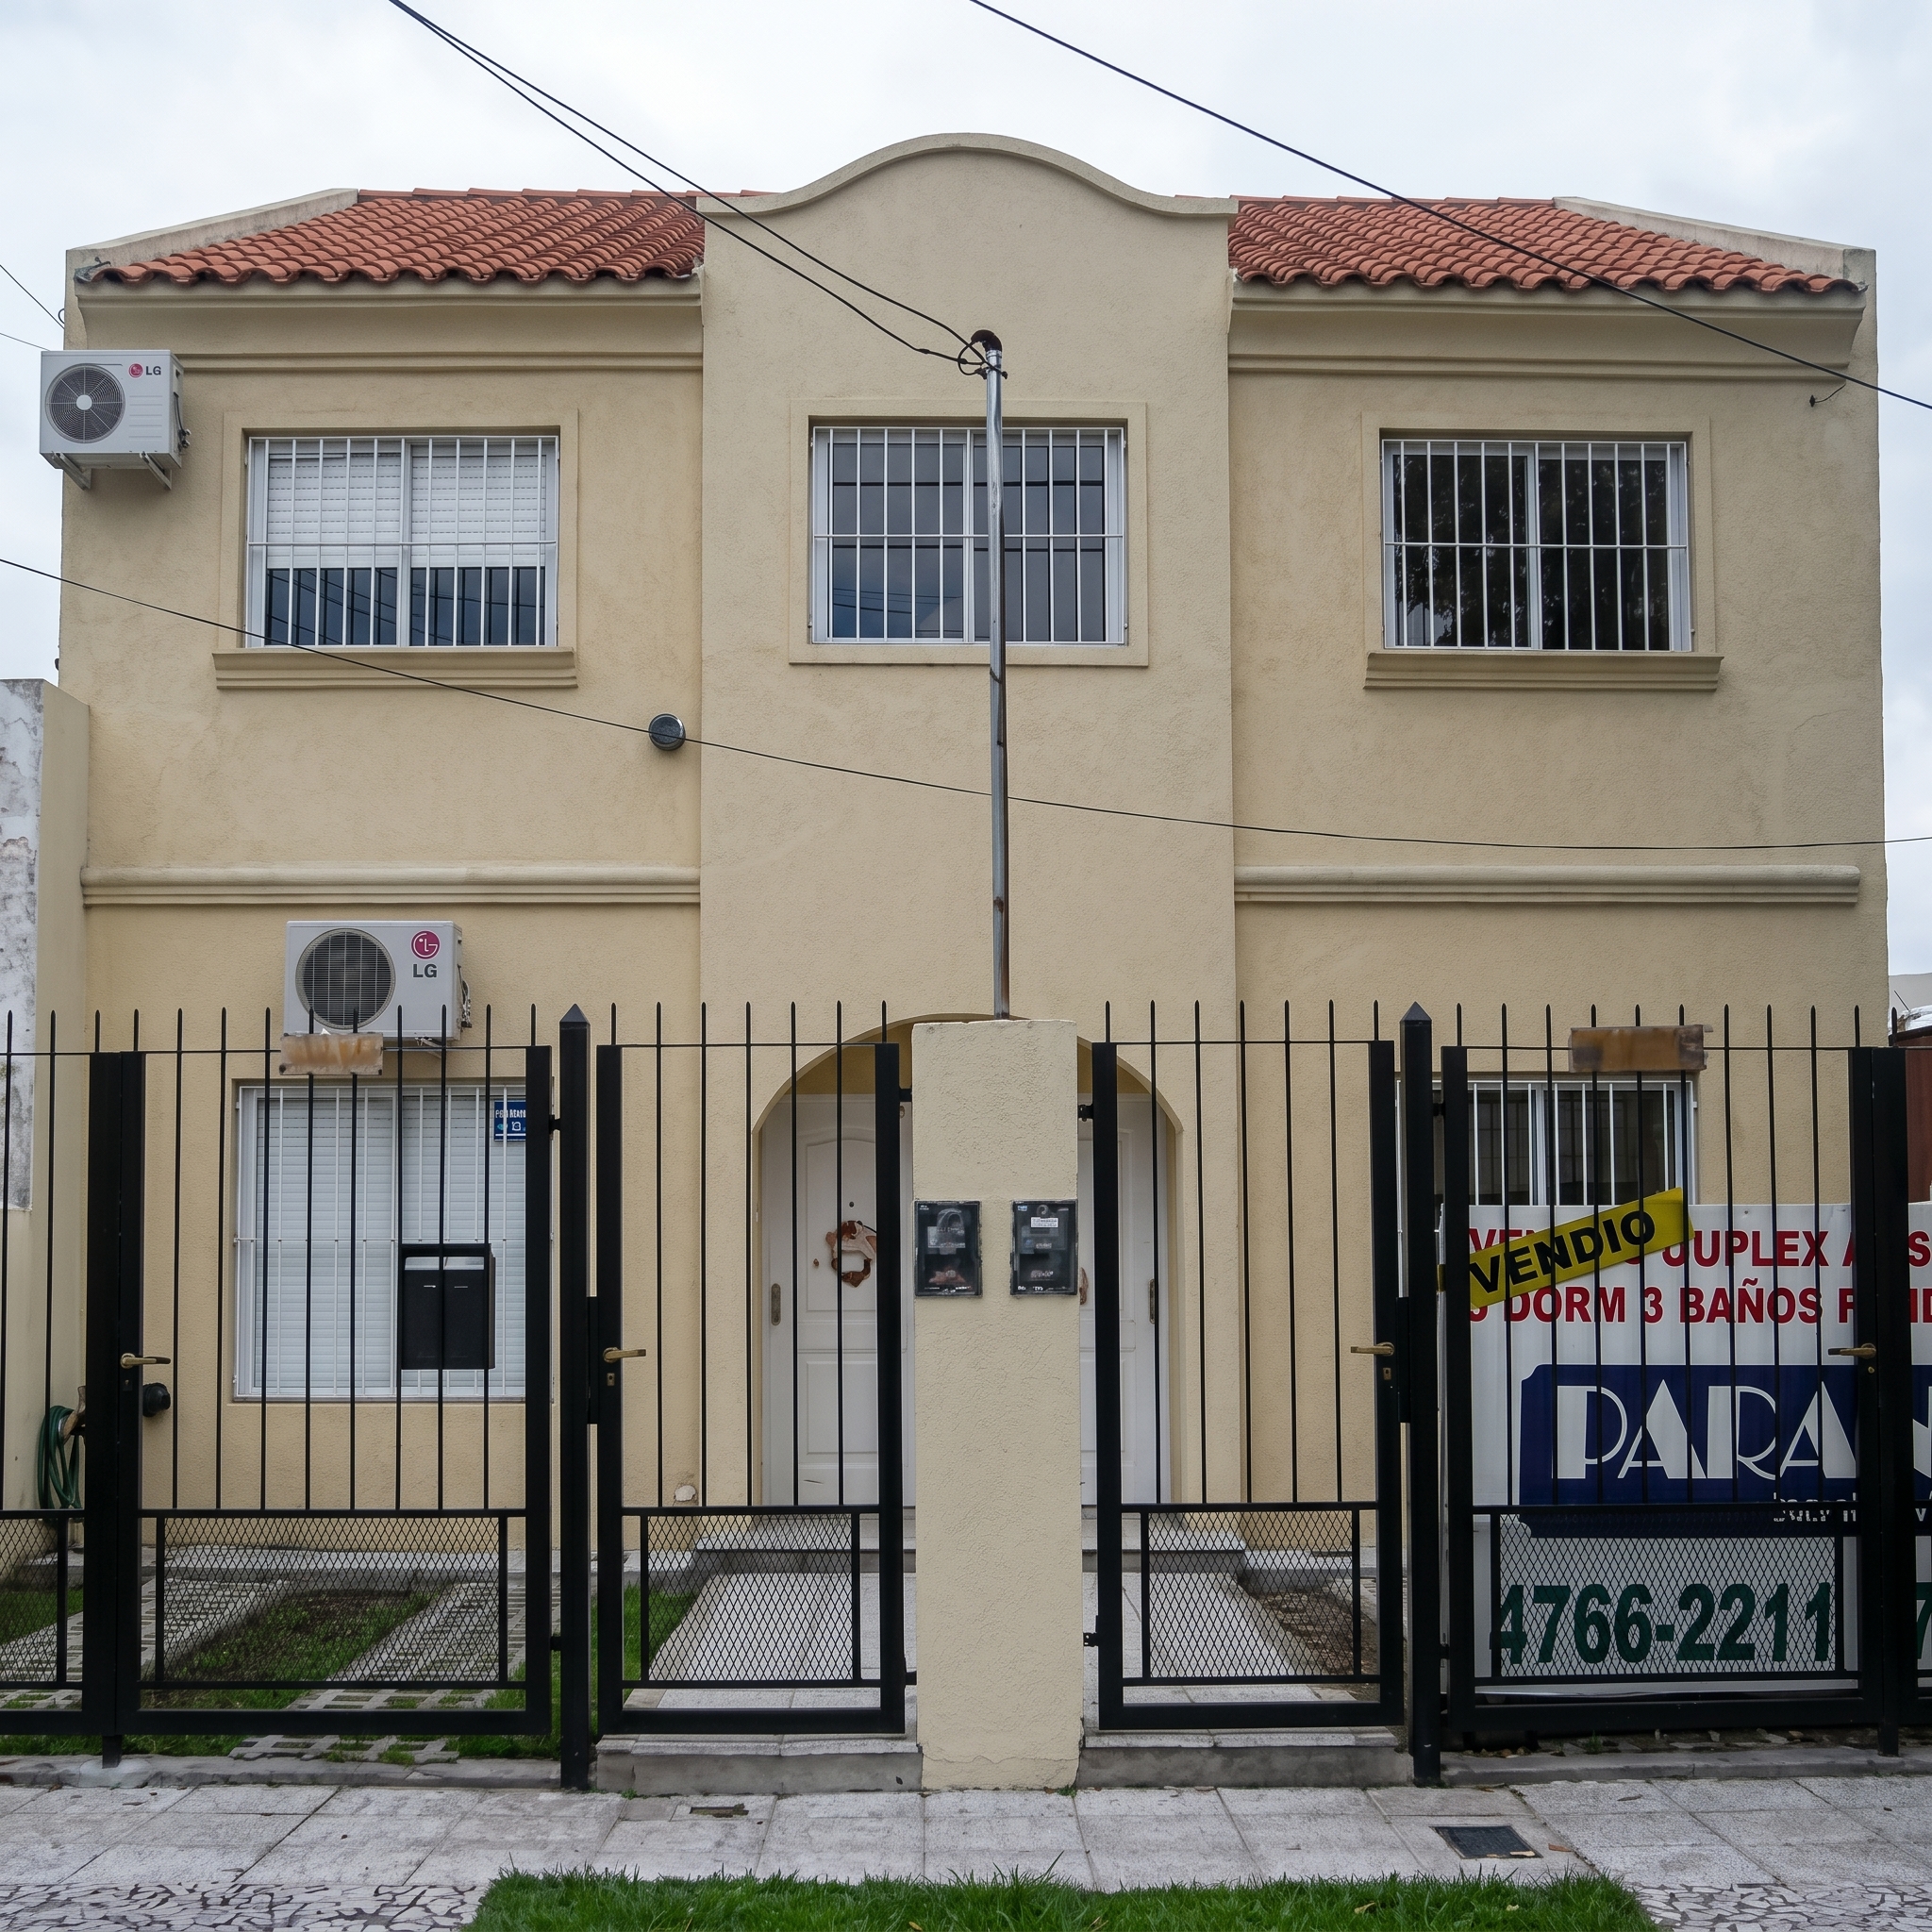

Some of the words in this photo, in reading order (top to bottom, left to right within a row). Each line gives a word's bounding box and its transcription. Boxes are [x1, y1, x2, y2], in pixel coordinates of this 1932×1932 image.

[145, 365, 161, 376] LG
[412, 963, 438, 978] LG
[1469, 1209, 1656, 1294] VENDIO
[1644, 1286, 1664, 1324] 3
[1679, 1277, 1822, 1324] BAÑOS
[1492, 1582, 1831, 1665] 4766-2211
